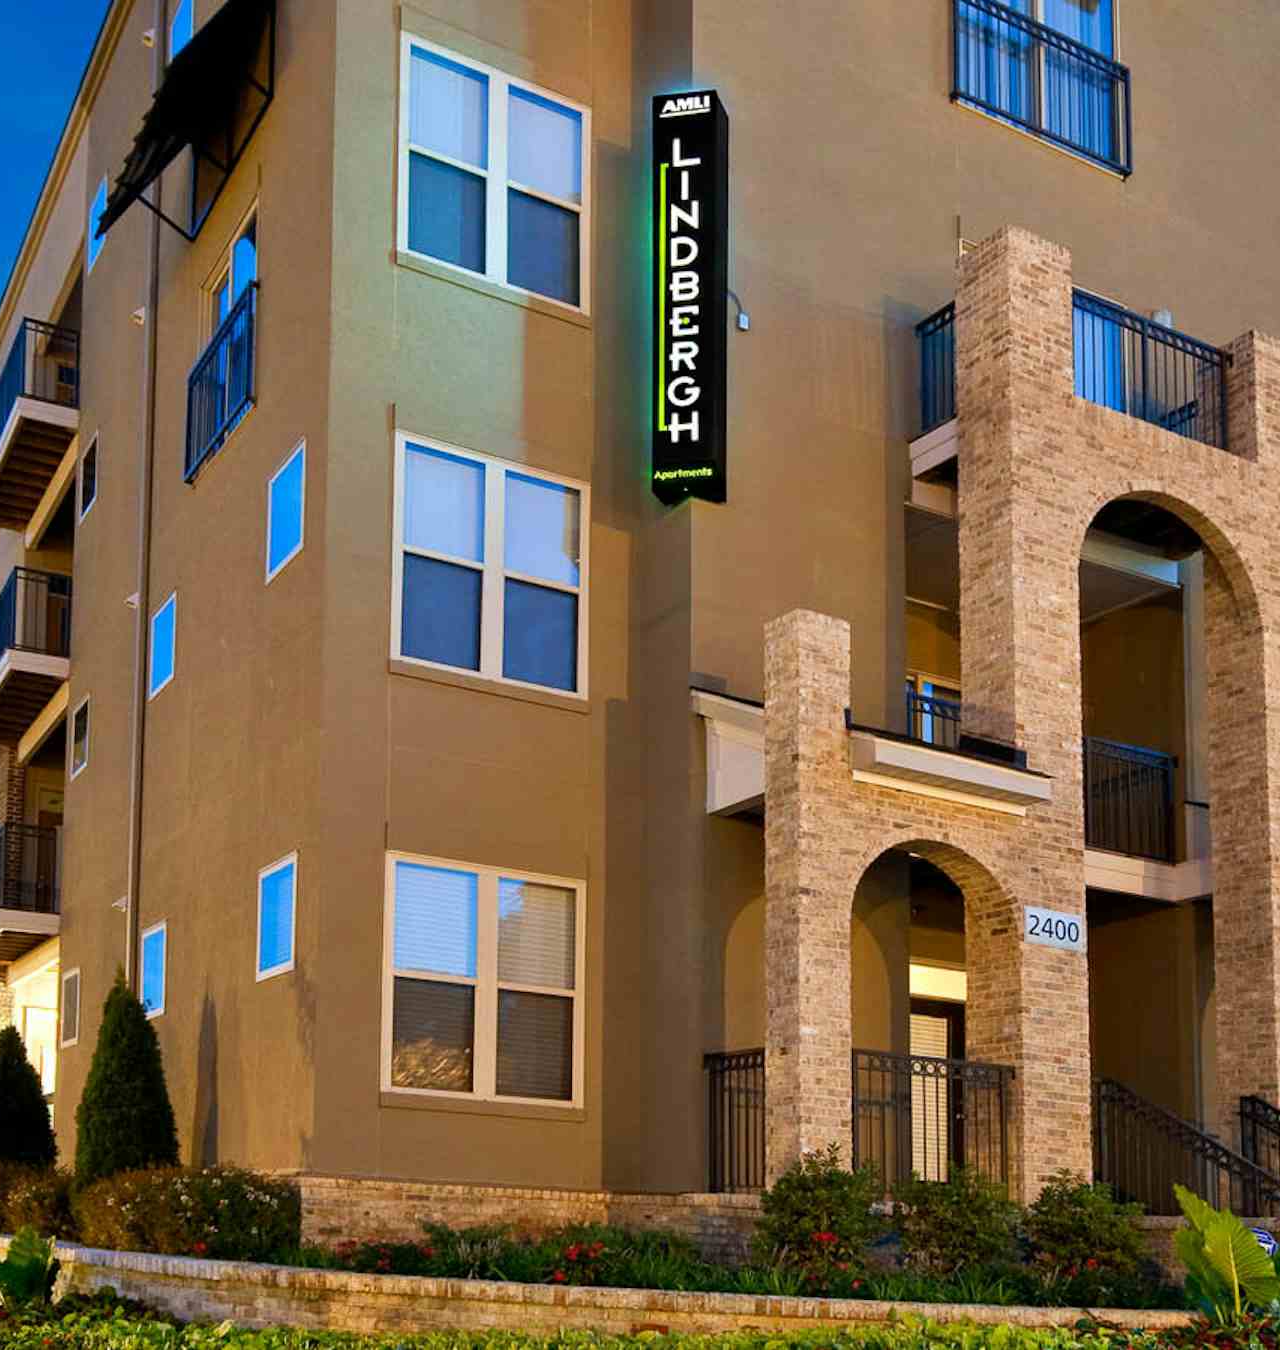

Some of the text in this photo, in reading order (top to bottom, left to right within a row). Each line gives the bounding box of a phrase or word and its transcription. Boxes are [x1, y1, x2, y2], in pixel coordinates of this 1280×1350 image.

[661, 95, 710, 113] AMLI
[667, 138, 701, 443] LINDBERGH
[654, 467, 712, 480] Apartments
[1029, 914, 1079, 943] 2400
